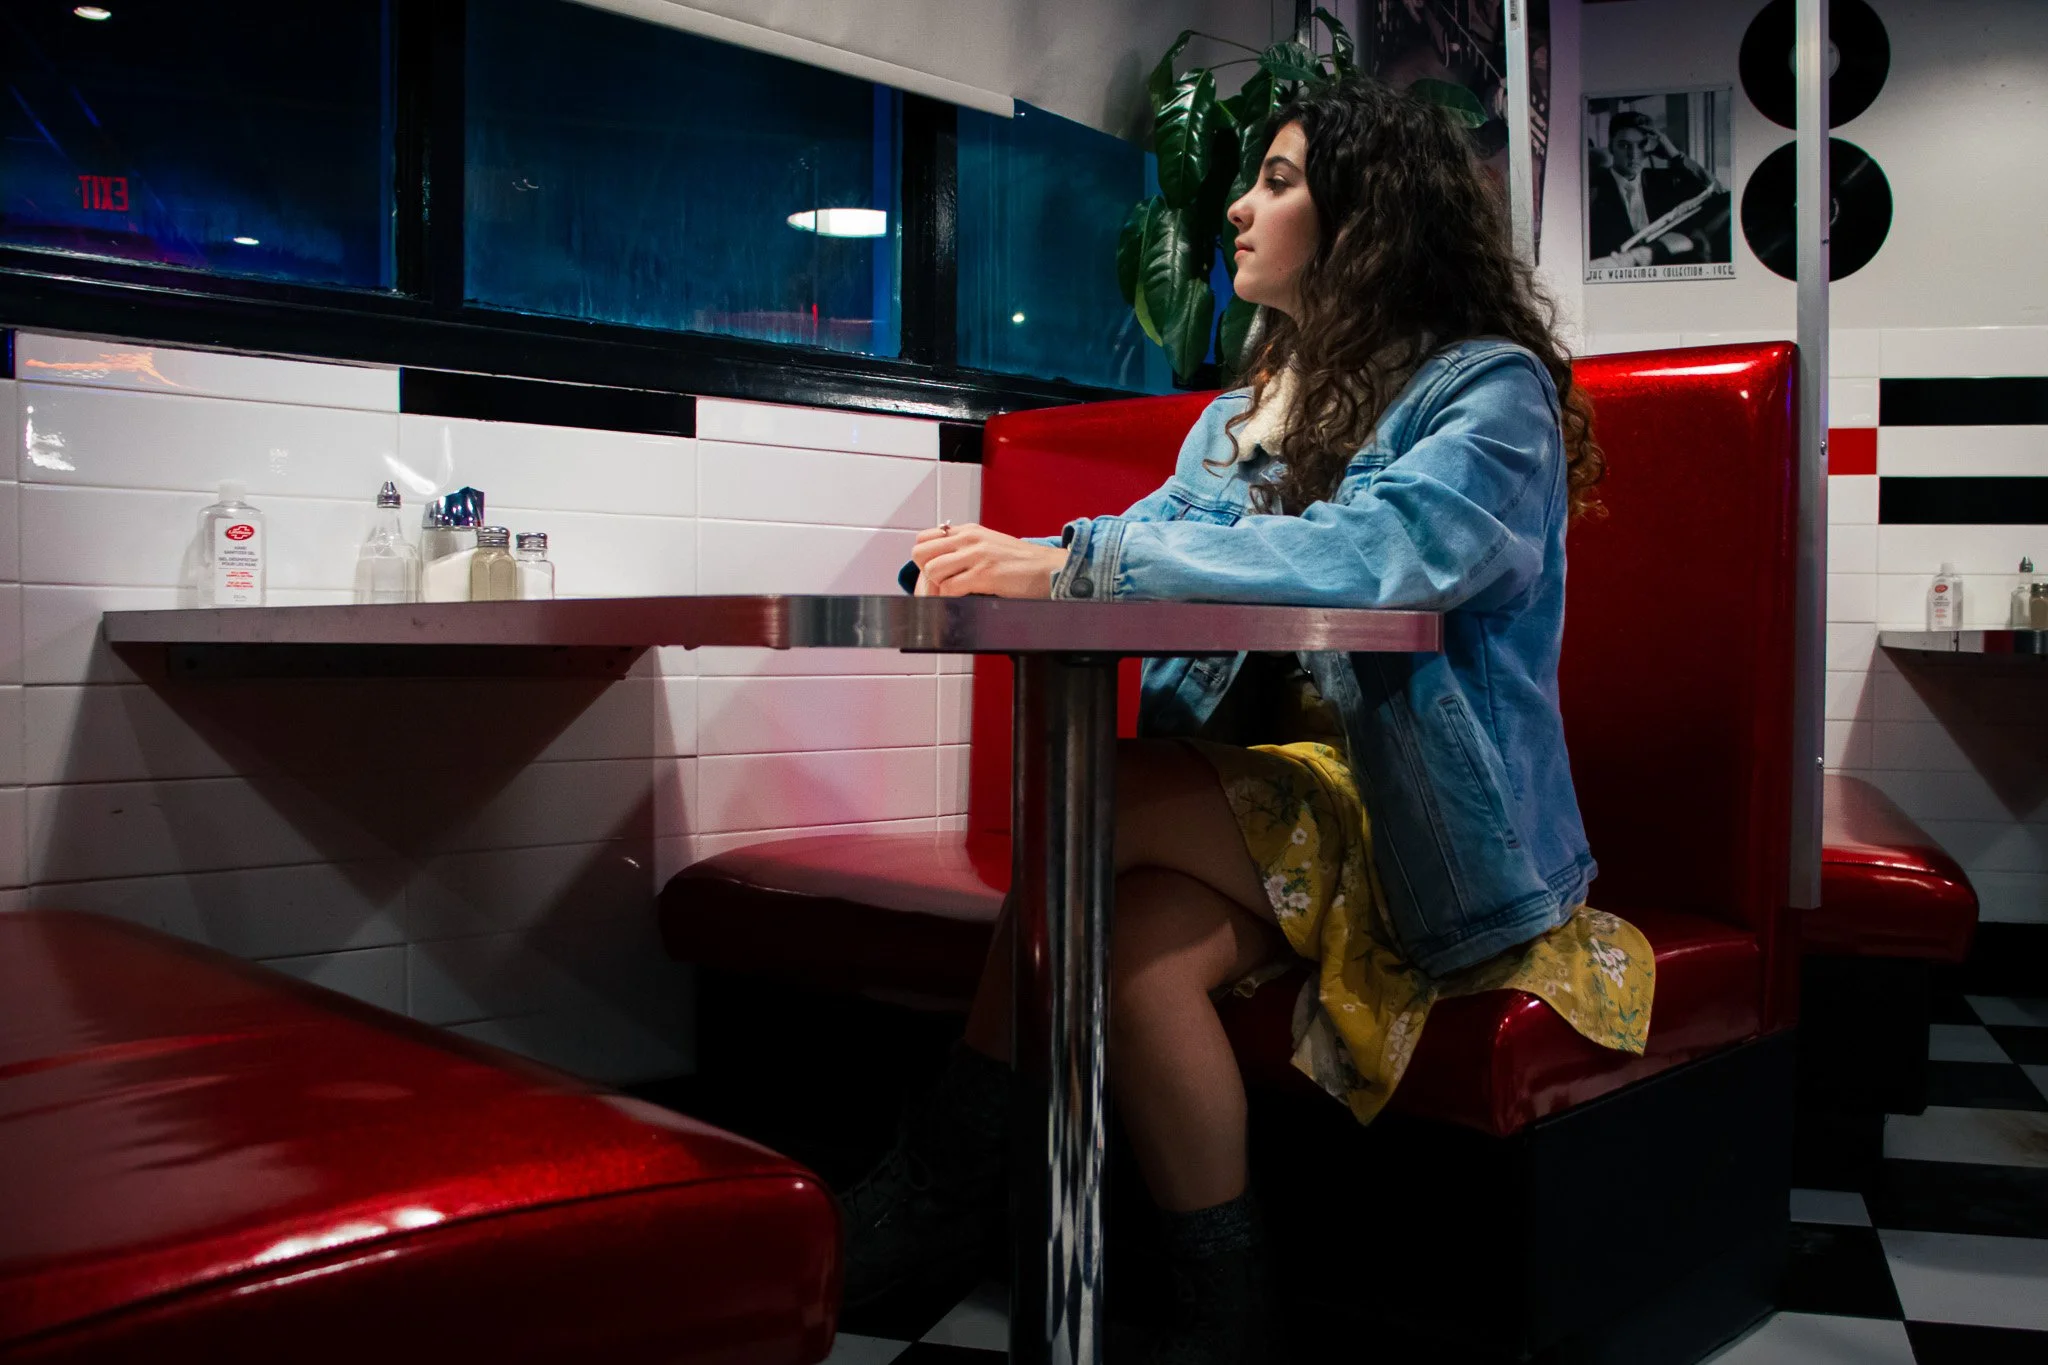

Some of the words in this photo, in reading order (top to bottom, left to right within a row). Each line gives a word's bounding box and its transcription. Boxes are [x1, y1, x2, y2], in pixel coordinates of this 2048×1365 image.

[1586, 270, 1602, 281] THE
[1608, 268, 1658, 280] WERTHEIMER
[1663, 266, 1703, 278] COLLECTION
